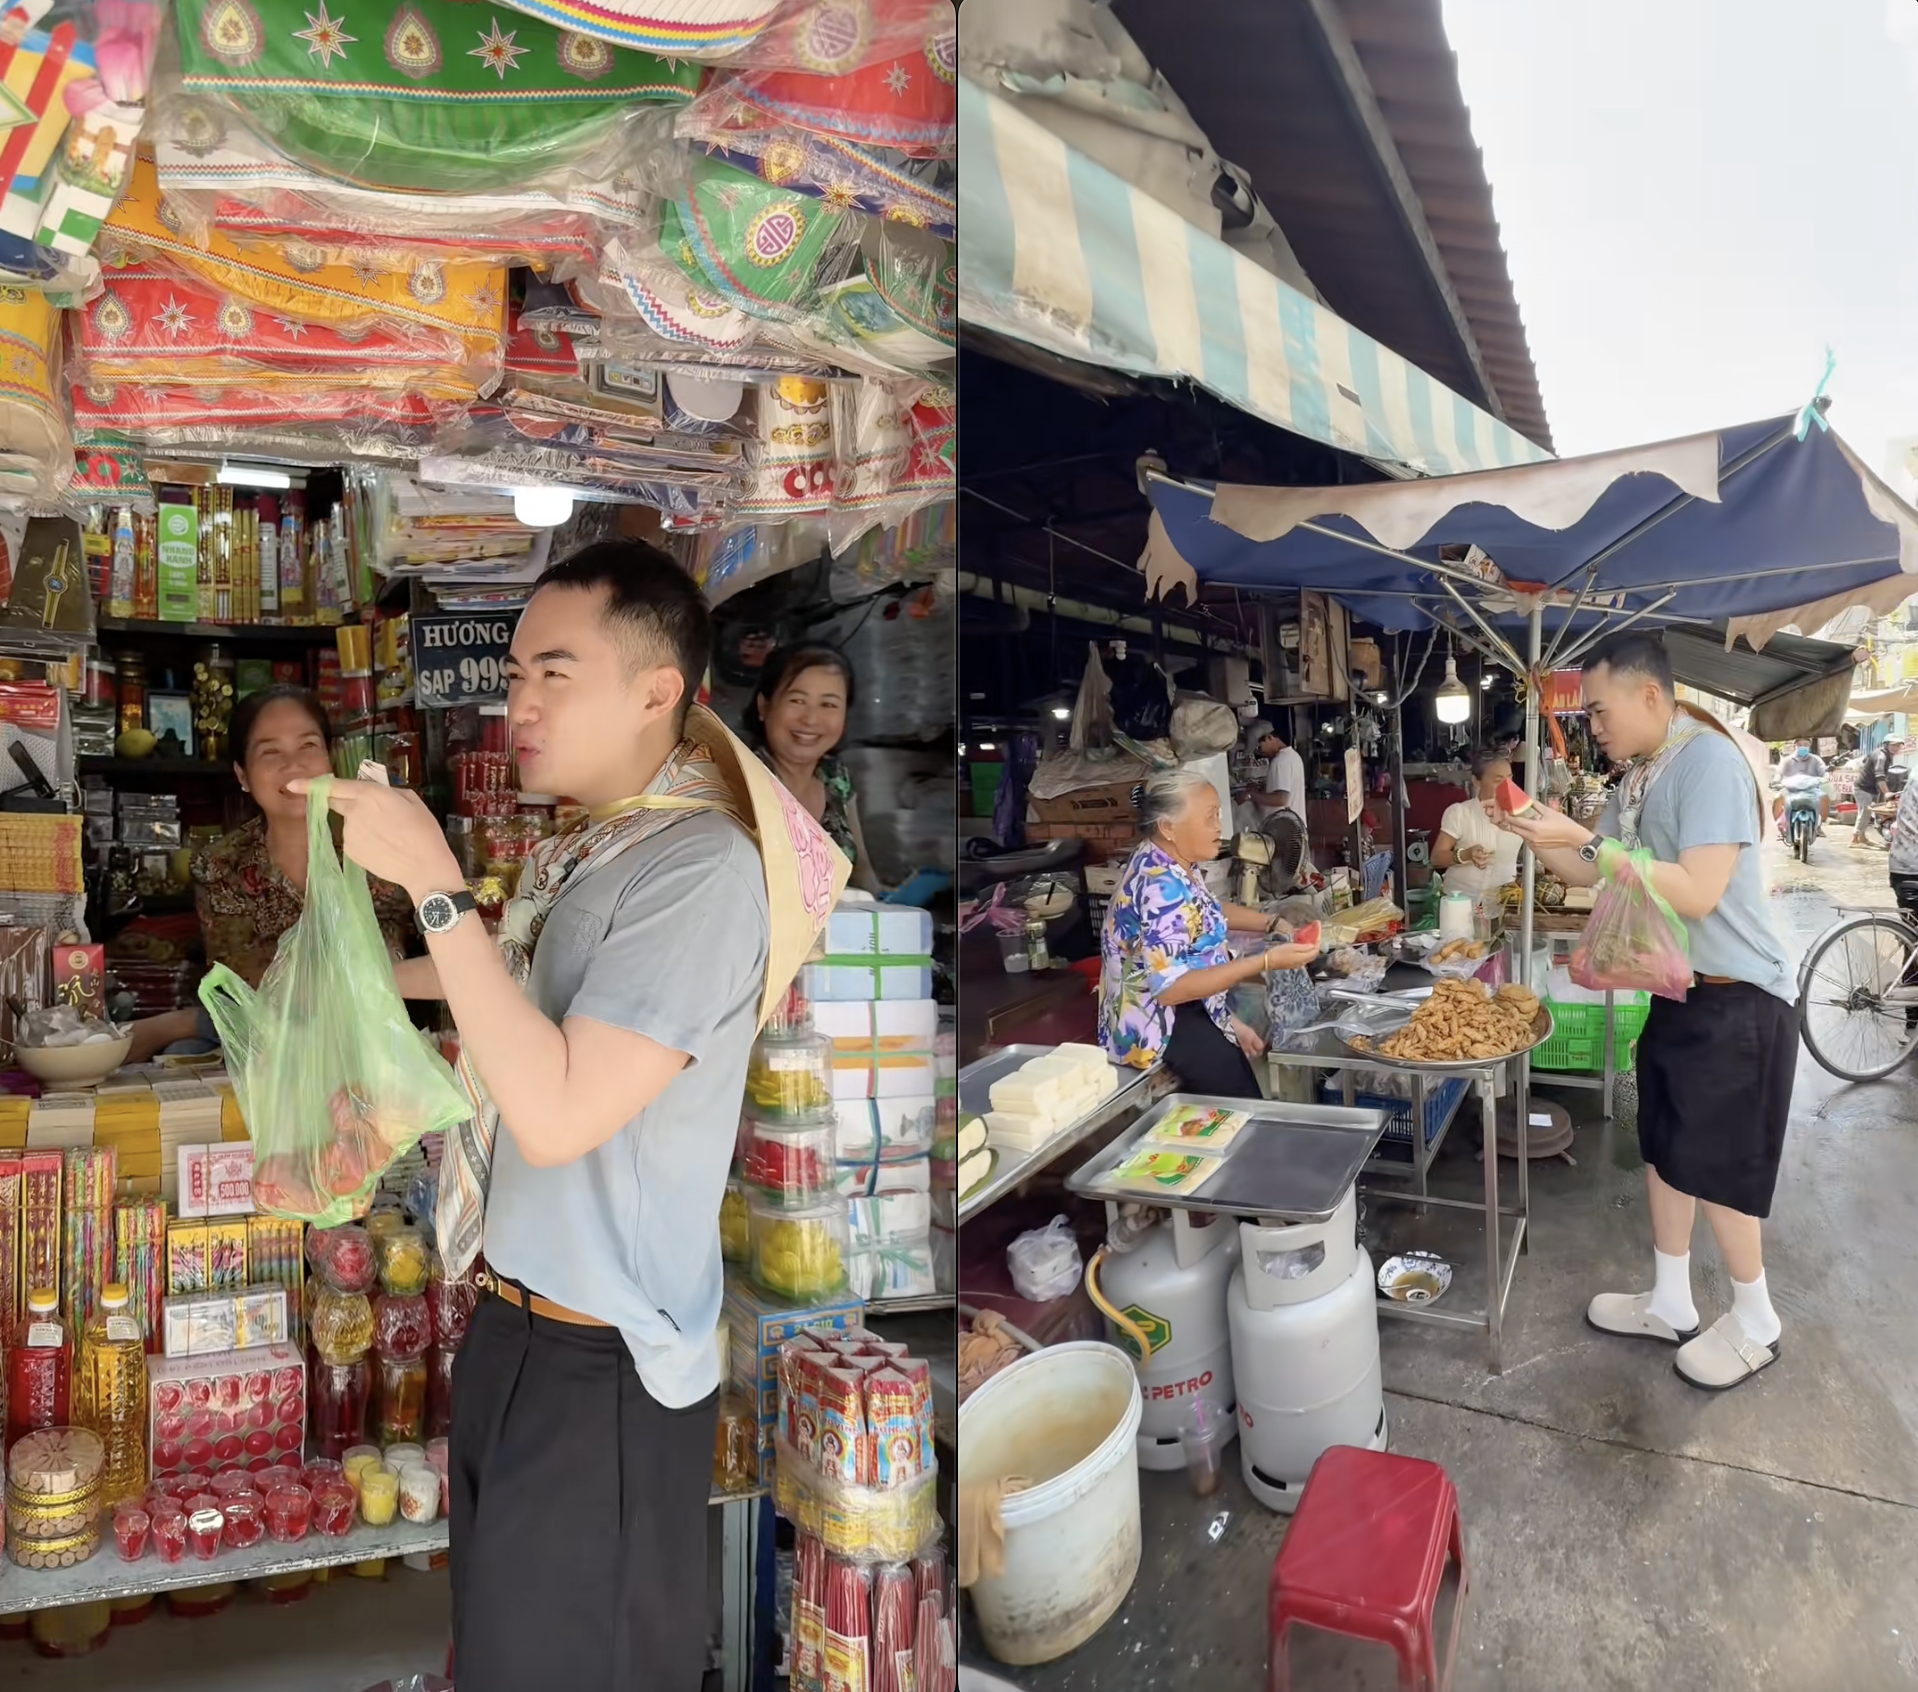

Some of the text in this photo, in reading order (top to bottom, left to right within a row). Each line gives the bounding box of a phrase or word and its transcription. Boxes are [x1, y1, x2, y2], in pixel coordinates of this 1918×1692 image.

[422, 620, 510, 647] HƯƠNG
[220, 1181, 250, 1198] 500.000
[1152, 1370, 1213, 1400] PETRO
